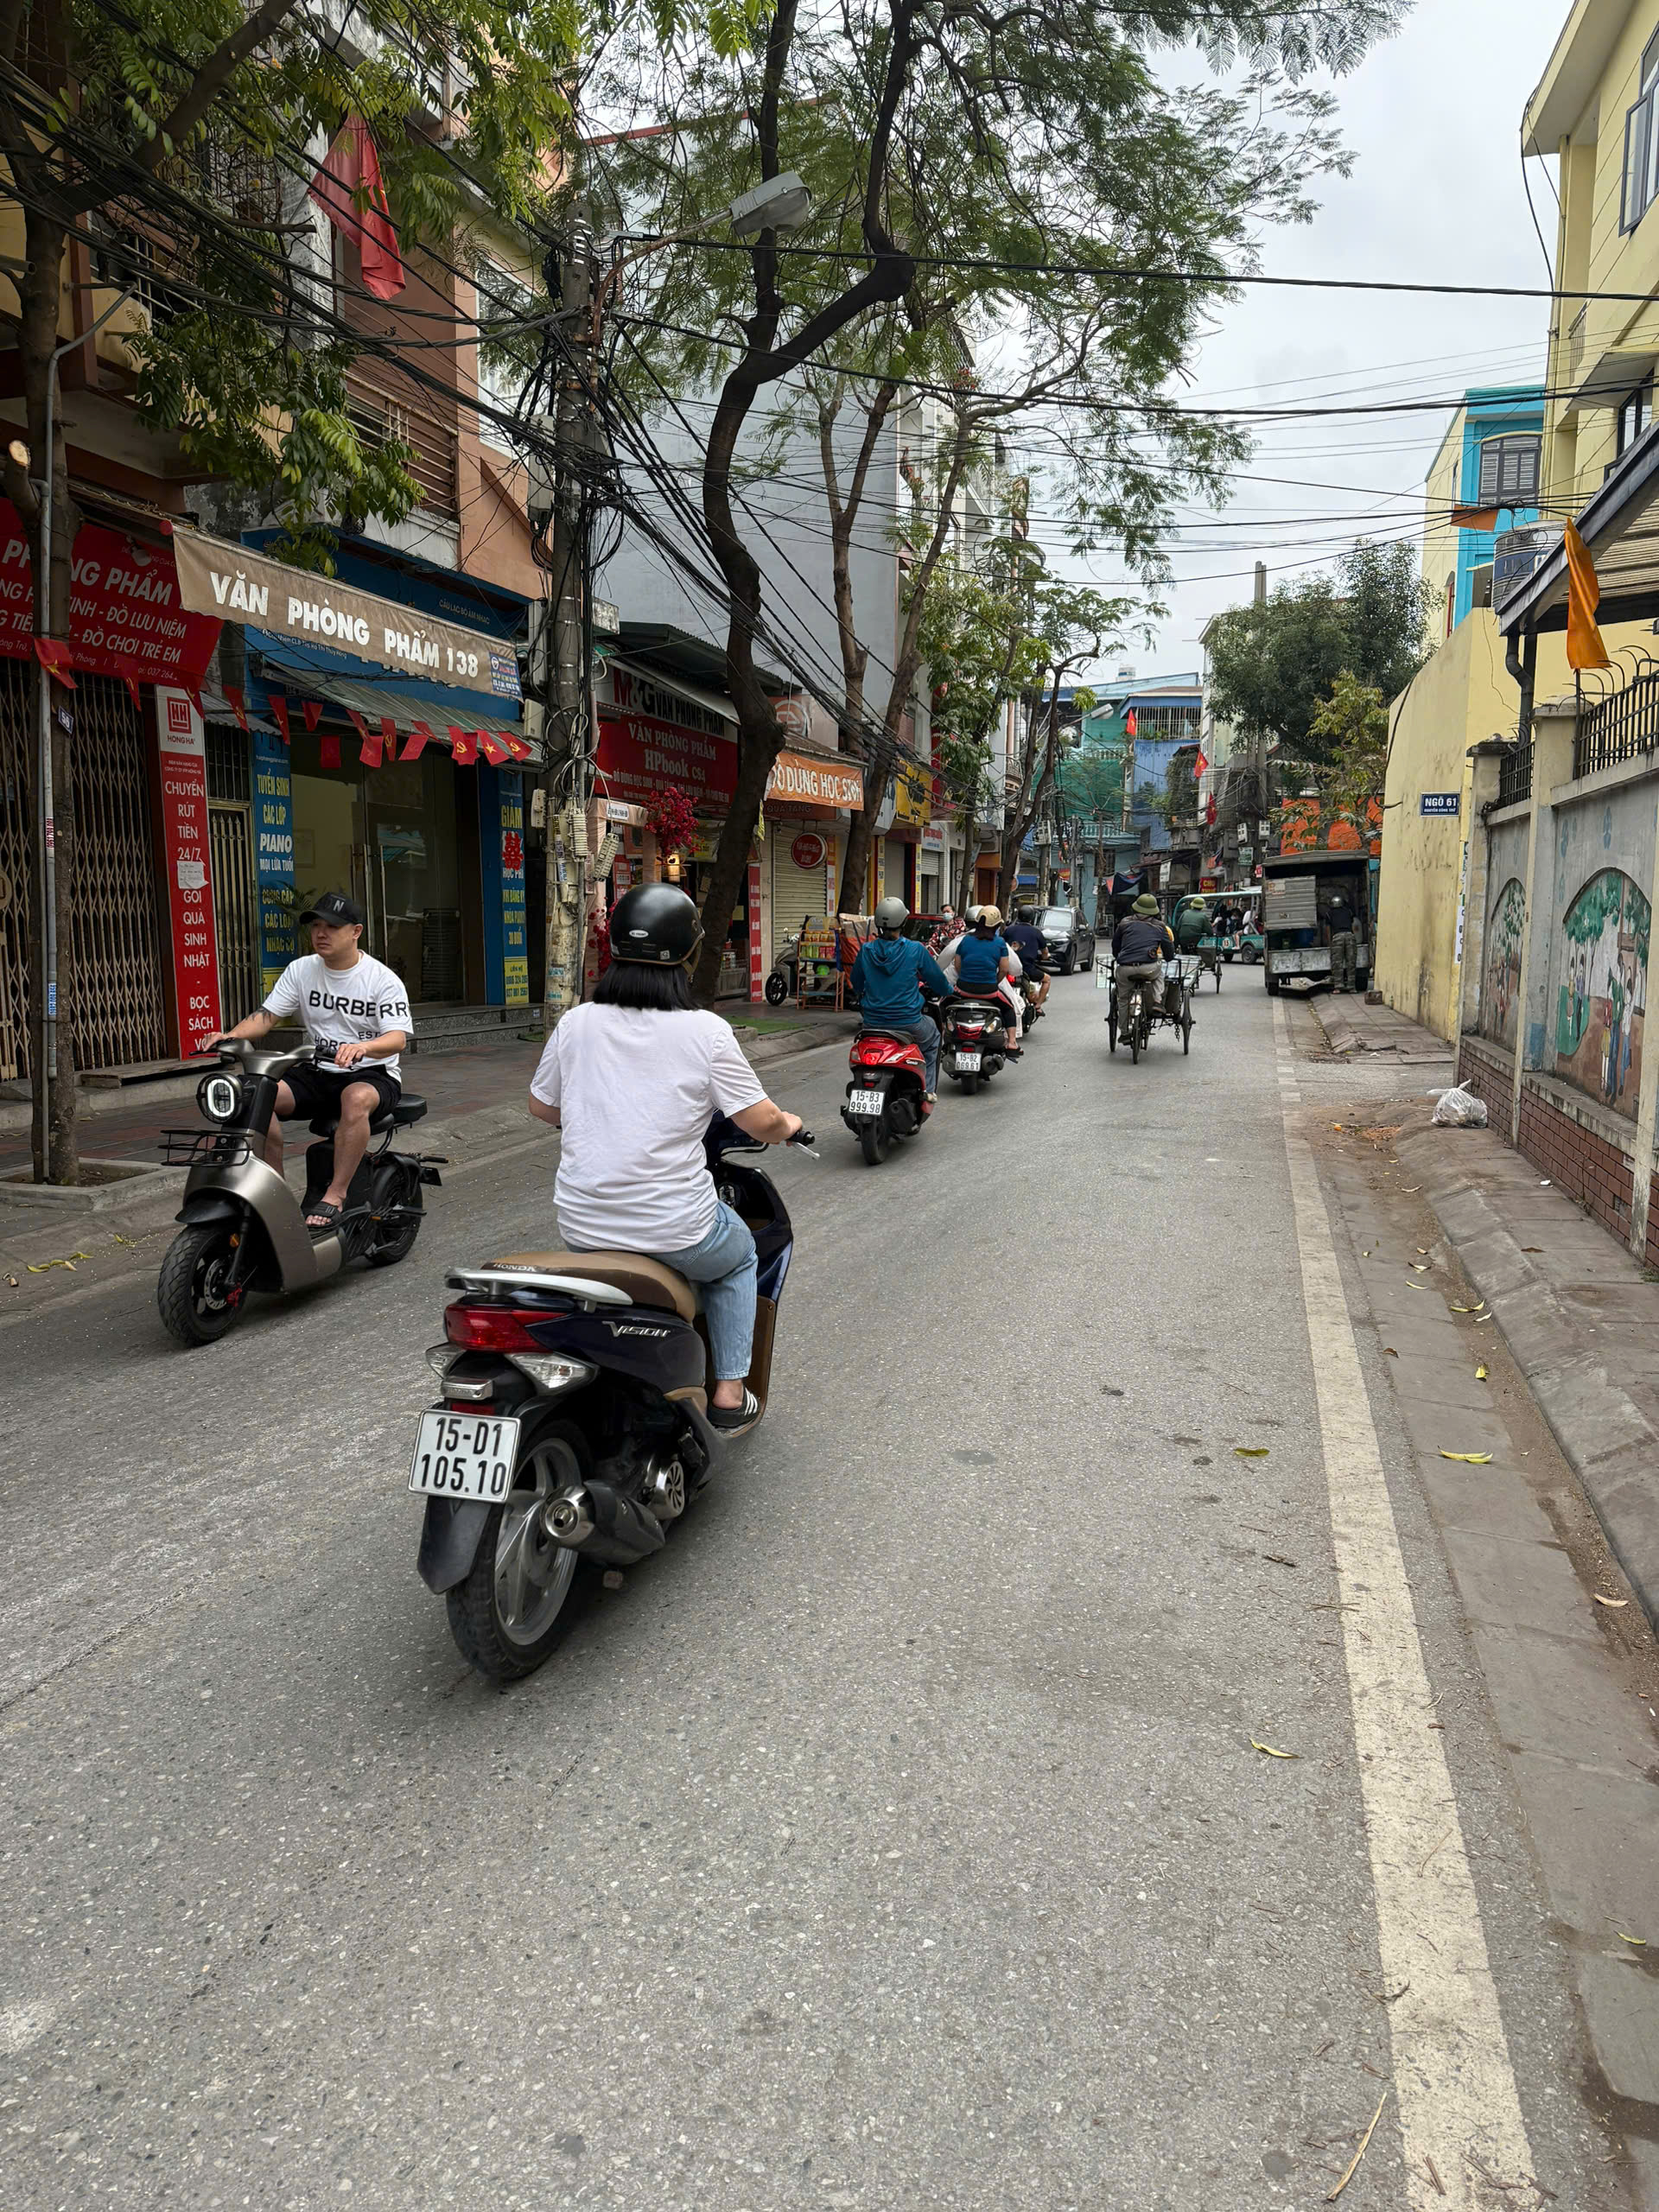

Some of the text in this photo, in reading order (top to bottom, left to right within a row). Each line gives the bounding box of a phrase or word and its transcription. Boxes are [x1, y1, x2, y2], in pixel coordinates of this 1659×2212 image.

[104, 567, 173, 606] PHẨM
[105, 603, 129, 625] ĐỒ
[130, 613, 156, 632] LƯU
[156, 618, 188, 639] NIỆM
[210, 569, 269, 616] VĂN
[288, 597, 370, 646] PHÒNG
[384, 627, 440, 669] PHẨM
[447, 647, 479, 677] 138
[82, 626, 105, 647] ĐỒ
[106, 634, 139, 655] CHƠI
[141, 640, 162, 658] TRẺ
[162, 648, 182, 664] EM
[628, 721, 716, 760] VĂN PHÒNG PHẨM
[644, 748, 689, 779] HPbook
[165, 779, 204, 797] CHUYỂN
[257, 767, 289, 796] TUYỂN SINH
[785, 759, 818, 797] DÙNG
[819, 773, 842, 804] HỌC
[842, 778, 863, 802] SINH
[178, 801, 195, 817] RÚT
[1425, 796, 1457, 807] NGÕ 61
[263, 802, 286, 825] CÁC LỚP
[177, 822, 199, 839] TIỀN
[259, 833, 293, 854] PIANO
[177, 848, 201, 861] 24/7
[184, 932, 207, 946] SINH
[183, 951, 210, 969] NHẬT
[190, 995, 210, 1012] BỌC
[309, 989, 409, 1019] BURBERR
[188, 1013, 213, 1031] SÁCH
[856, 1091, 880, 1103] 15-B3
[850, 1102, 880, 1114] 999.98
[493, 1262, 537, 1273] HONDA
[436, 1417, 502, 1457] 15-D1
[421, 1453, 506, 1495] 105.10
